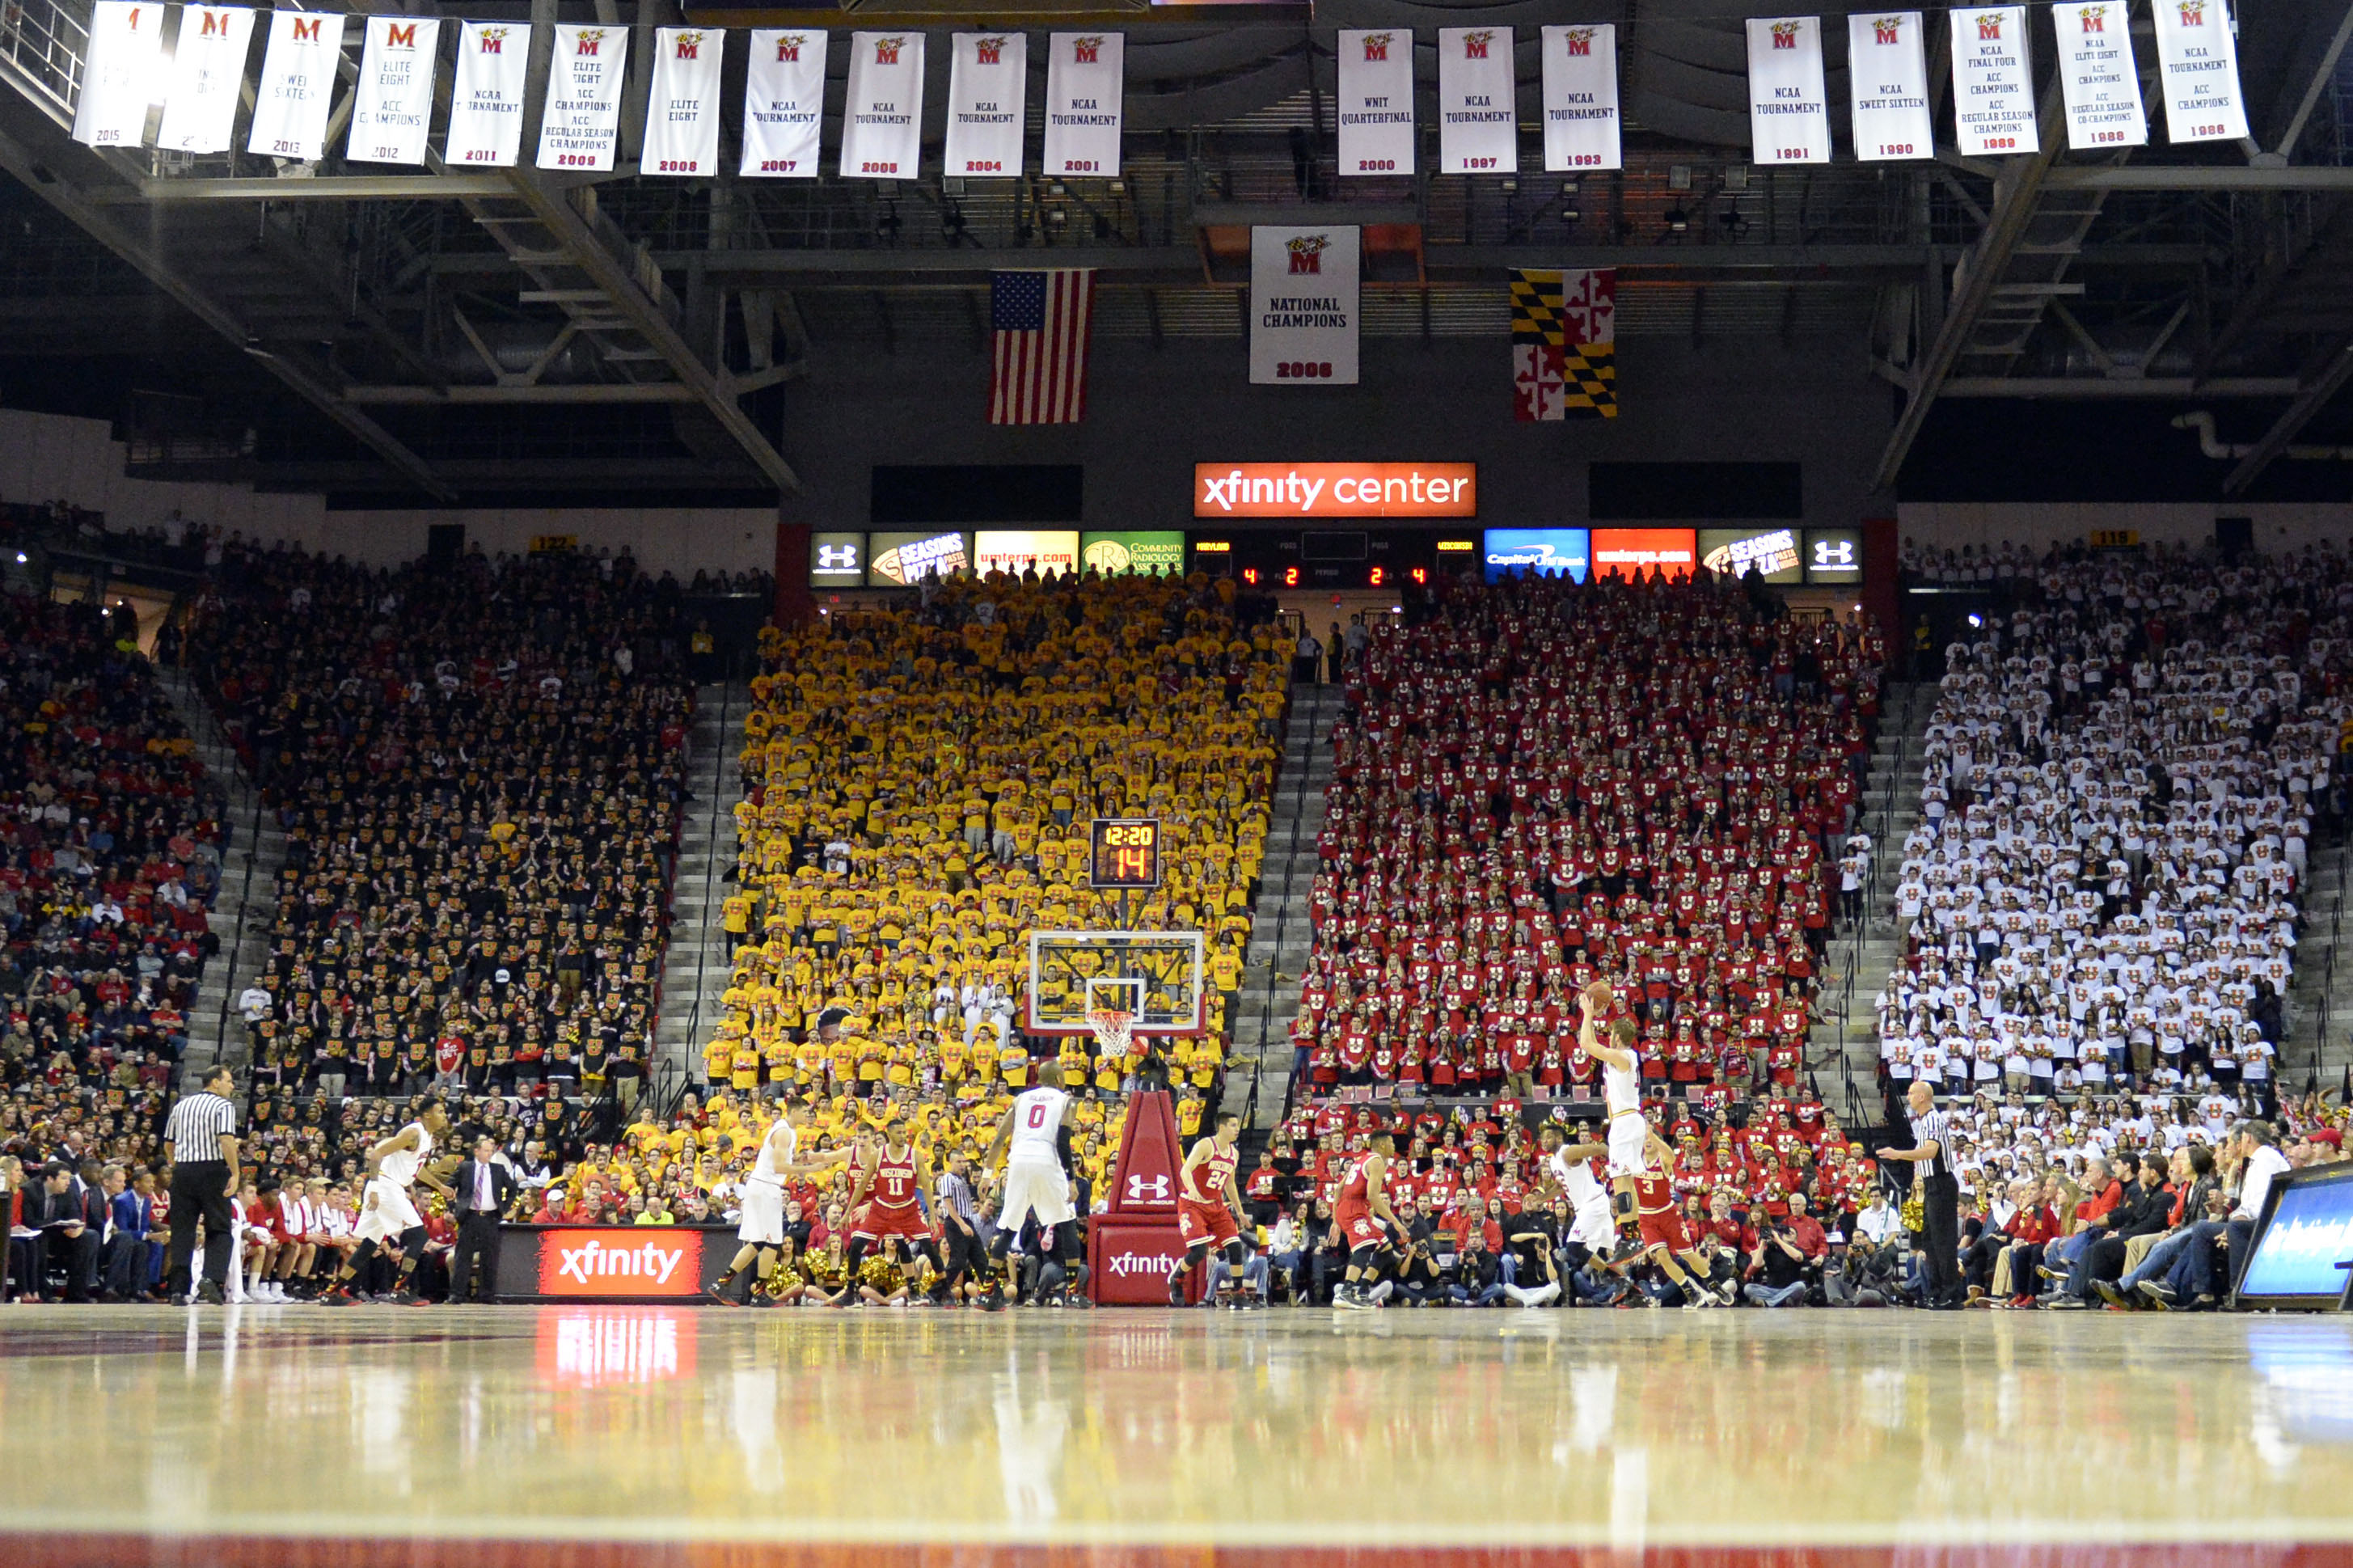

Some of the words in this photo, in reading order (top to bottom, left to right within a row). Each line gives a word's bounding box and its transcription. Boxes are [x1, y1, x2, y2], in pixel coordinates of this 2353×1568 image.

[2182, 11, 2202, 26] M
[2083, 18, 2104, 32] M
[387, 23, 418, 48] M
[1877, 29, 1898, 44] M
[1979, 25, 2000, 40] M
[481, 38, 502, 53] M
[1773, 34, 1795, 49] M
[2085, 39, 2105, 48] NCAA
[577, 40, 598, 56] M
[677, 43, 697, 59] M
[777, 45, 799, 61] M
[1366, 45, 1388, 61] M
[1466, 43, 1488, 57] M
[1569, 40, 1590, 56] M
[1980, 46, 2002, 56] NCAA
[2185, 48, 2208, 57] NCAA
[877, 49, 898, 64] M
[978, 49, 999, 64] M
[1075, 48, 1097, 63] M
[2075, 52, 2095, 61] ELITE
[2097, 50, 2119, 60] EIGHT
[382, 61, 412, 73] ELITE
[573, 62, 602, 72] ELITE
[1968, 57, 1992, 68] FINAL
[1996, 57, 2017, 66] FOUR
[2169, 59, 2227, 74] TOURNAMENT
[2092, 65, 2106, 73] ACC
[380, 74, 411, 85] EIGHT
[1987, 73, 2002, 82] ACC
[2079, 74, 2121, 84] CHAMPIONS
[475, 90, 501, 100] NCAA
[577, 89, 594, 99] ACC
[1775, 87, 1801, 98] NCAA
[1879, 84, 1902, 95] NCAA
[1971, 83, 2019, 95] CHAMPIONS
[2194, 84, 2210, 95] ACC
[1364, 97, 1388, 108] WNIT
[1465, 95, 1490, 107] NCAA
[1568, 93, 1594, 104] NCAA
[2096, 93, 2109, 101] ACC
[2178, 96, 2229, 110] CHAMPIONS
[381, 100, 402, 112] ACC
[455, 101, 519, 113] TURNAMENT
[556, 100, 612, 112] CHAMPIONS
[670, 99, 699, 109] ELITE
[771, 101, 796, 111] NCAA
[872, 103, 894, 112] NCAA
[975, 103, 997, 112] NCAA
[1071, 99, 1097, 110] NCAA
[1756, 103, 1821, 115] TOURNAMENT
[1859, 99, 1886, 110] SWEET
[1889, 98, 1924, 108] SIXTEEN
[1989, 100, 2004, 109] ACC
[2072, 103, 2105, 114] REGULAR
[2106, 101, 2135, 111] SEASON
[359, 112, 420, 126] CAMPIONS
[669, 112, 699, 121] EIGHT
[855, 114, 911, 125] TOURNAMENT
[957, 113, 1014, 124] TOURNAMENT
[1341, 112, 1412, 125] QUARTERFINAL
[1446, 111, 1511, 123] TOURNAMENT
[1548, 107, 1615, 120] TOURNAMENT
[1962, 112, 1999, 123] REGULAR
[2001, 110, 2033, 120] SEASON
[571, 116, 589, 125] ACC
[1051, 114, 1117, 126] TOURNAMENT
[545, 126, 582, 137] REGULAR
[584, 128, 614, 137] SEASON
[1974, 123, 2022, 133] CHAMPIONS
[97, 129, 120, 142] 2015
[273, 140, 300, 153] 2013
[550, 138, 607, 150] CHAMPIONS
[1880, 143, 1913, 155] 1990
[465, 150, 496, 162] 2011
[1776, 148, 1809, 159] 1991
[558, 154, 596, 166] 2009
[660, 160, 697, 171] 2008
[761, 160, 796, 171] 2007
[966, 161, 1002, 171] 2004
[1065, 160, 1099, 171] 2001
[1358, 159, 1395, 171] 2000
[1463, 158, 1497, 168] 1997
[1290, 251, 1320, 273] M
[1270, 298, 1340, 311] NATIONAL
[1263, 314, 1346, 328] CHAMPIONS
[1203, 471, 1325, 510] xfinity
[1334, 471, 1468, 503] center
[898, 532, 964, 565] SEASONS
[1729, 529, 1794, 562] SEASONS
[1487, 553, 1534, 565] Capital
[1244, 568, 1256, 584] 4
[1286, 568, 1298, 585] 2
[1371, 567, 1382, 585] 2
[1413, 568, 1425, 584] 4
[1106, 826, 1153, 846] 12:20
[1117, 848, 1146, 878] 14
[1028, 1104, 1046, 1128] 0
[888, 1177, 903, 1195] 11
[1206, 1170, 1228, 1190] 24
[1642, 1179, 1654, 1194] 3
[559, 1240, 682, 1284] xfinity
[1109, 1251, 1182, 1278] xfinity
